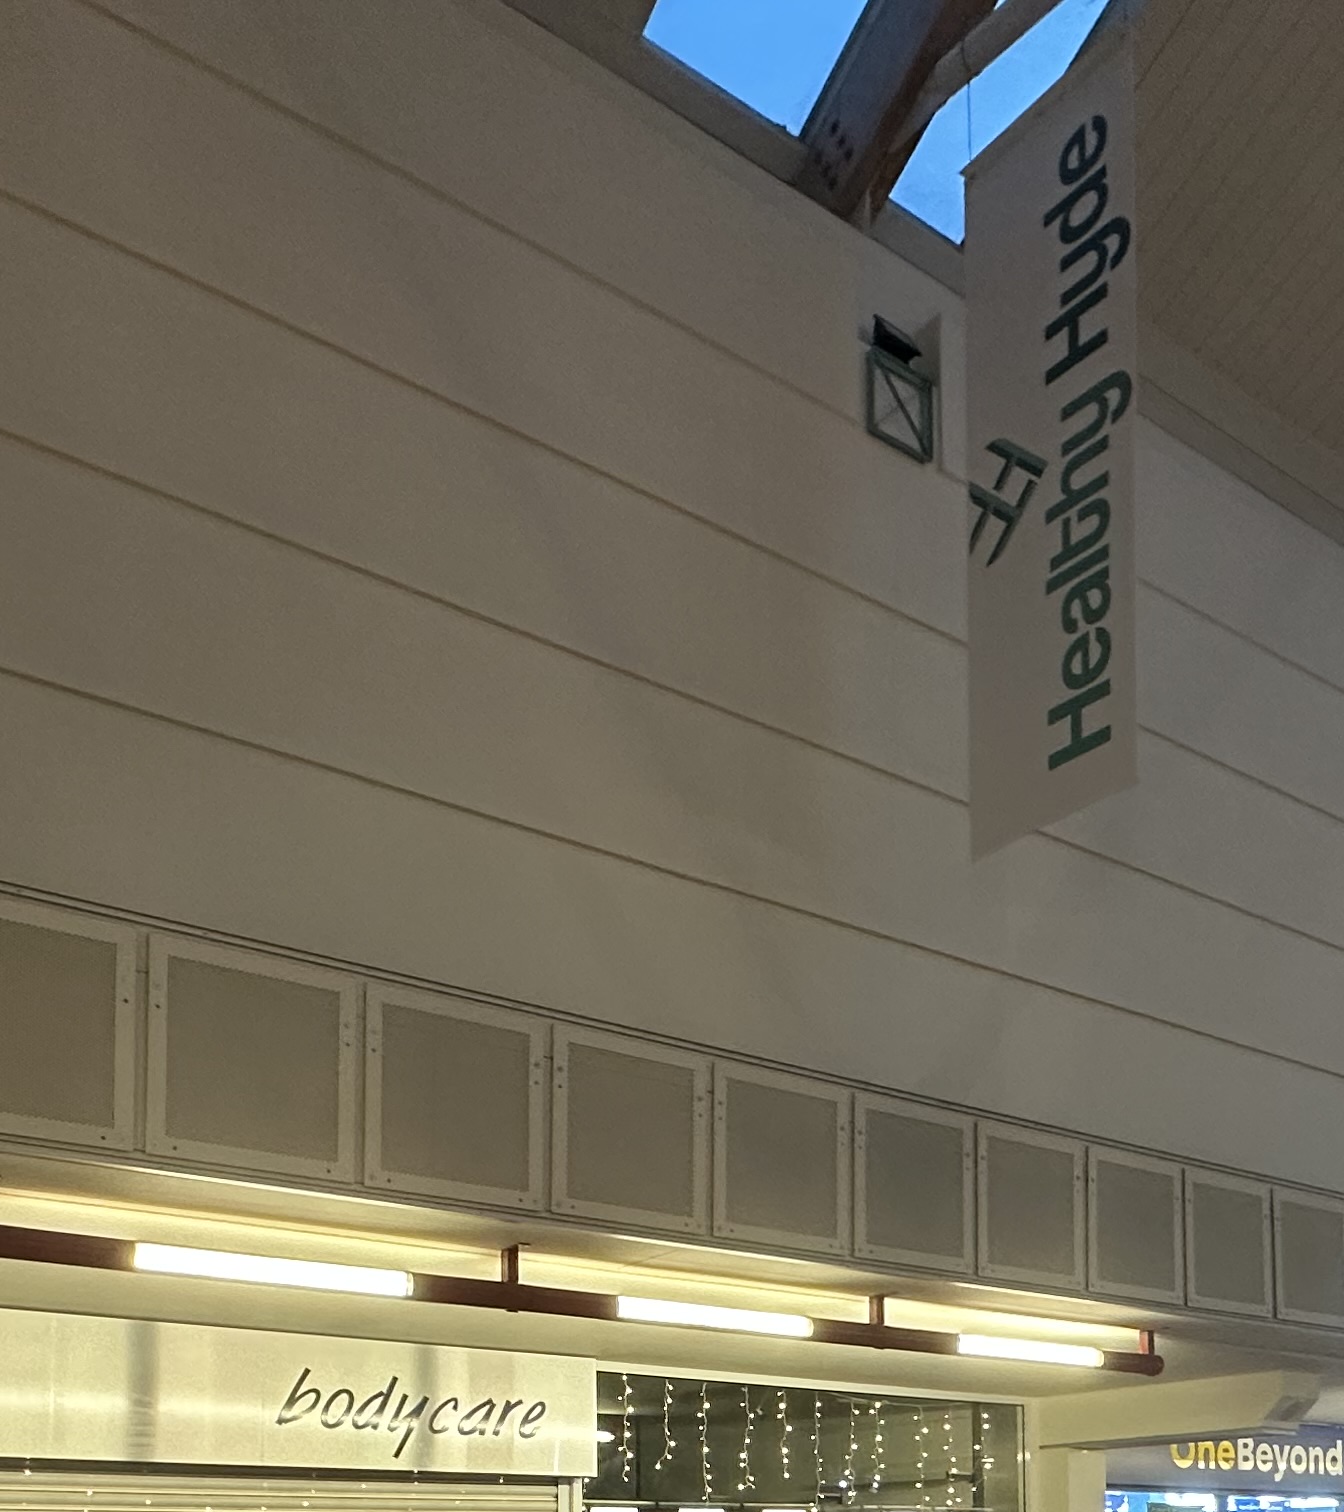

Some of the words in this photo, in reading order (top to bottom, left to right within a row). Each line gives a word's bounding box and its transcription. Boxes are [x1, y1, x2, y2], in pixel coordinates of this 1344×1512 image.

[1043, 115, 1131, 387] Hyde
[1044, 369, 1133, 771] Healthy
[275, 1367, 547, 1459] bodycare
